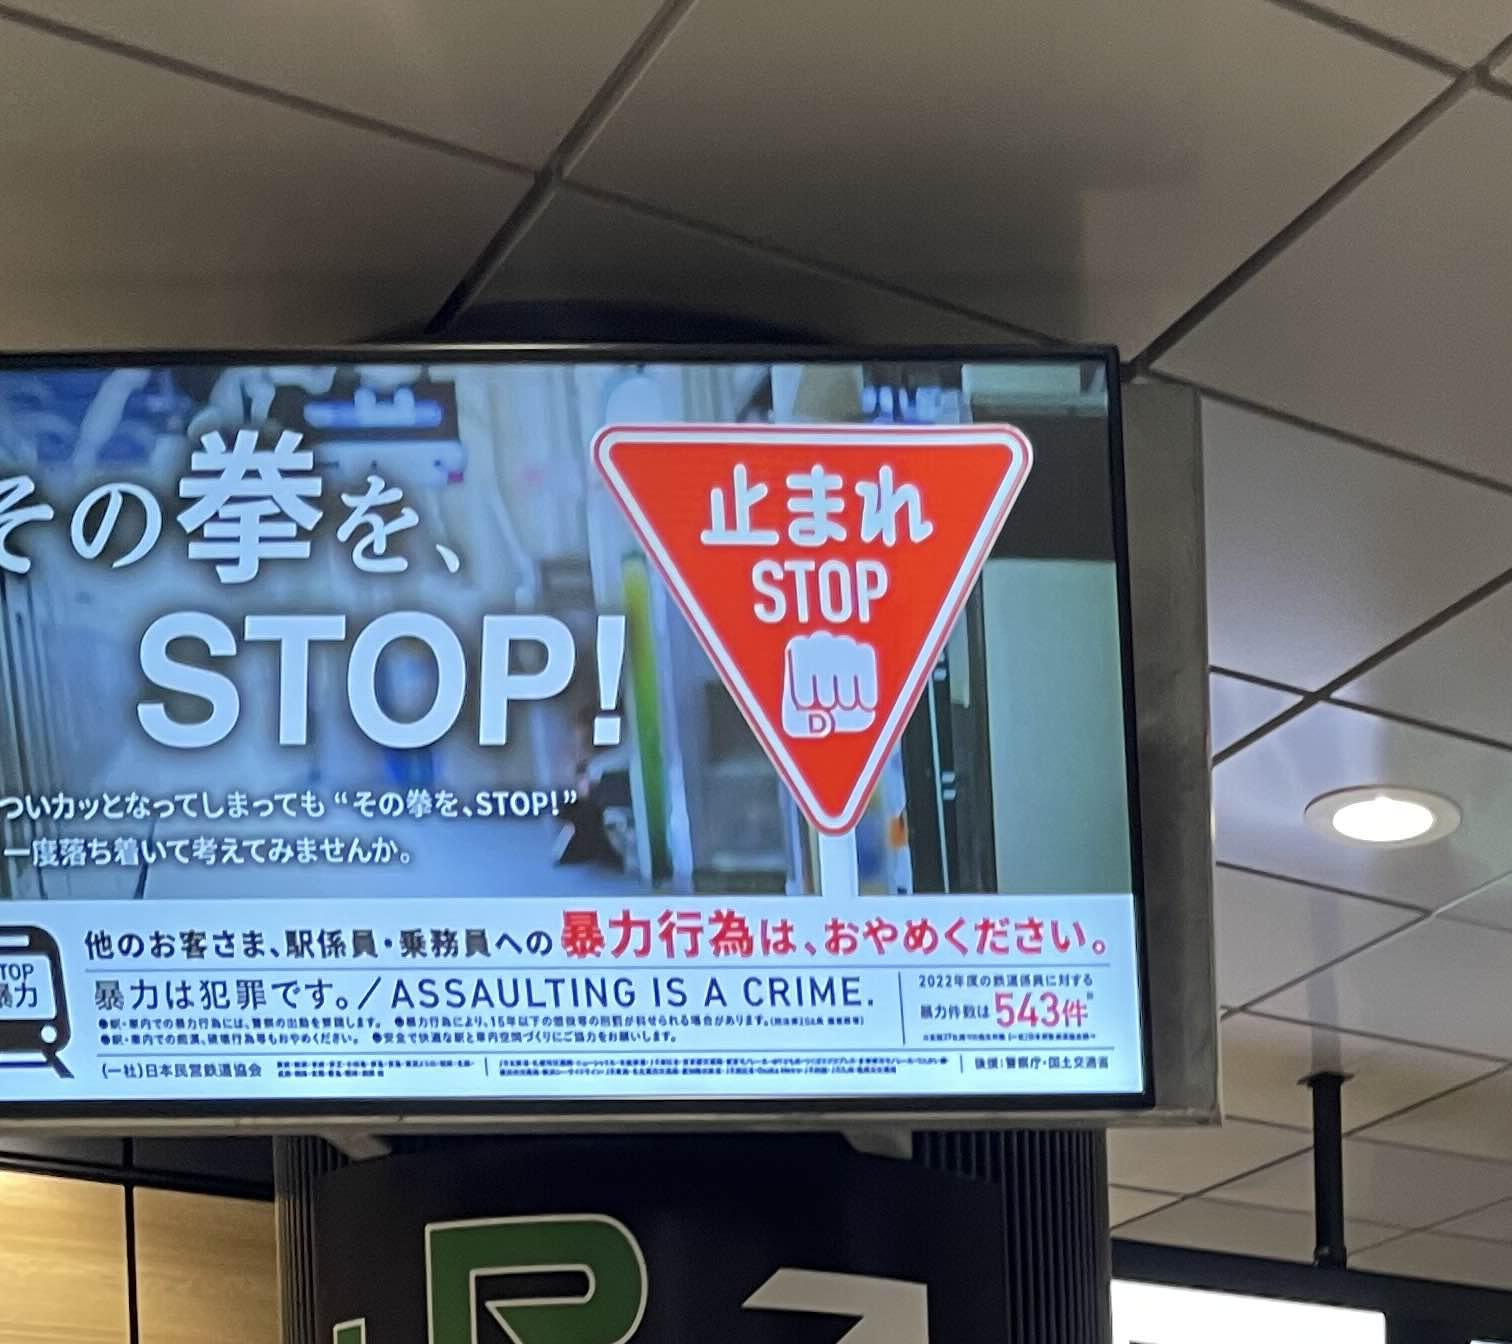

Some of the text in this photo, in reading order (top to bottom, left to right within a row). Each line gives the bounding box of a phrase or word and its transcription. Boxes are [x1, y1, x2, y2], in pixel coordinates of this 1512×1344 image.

[701, 464, 933, 547] 止まれ
[752, 560, 888, 624] STOP
[137, 611, 627, 749] STOP!
[4, 838, 411, 867] 一度落ち着いて考えてみませんか。
[653, 976, 688, 1008] IS
[703, 977, 728, 1008] A
[743, 975, 876, 1007] CRIME.
